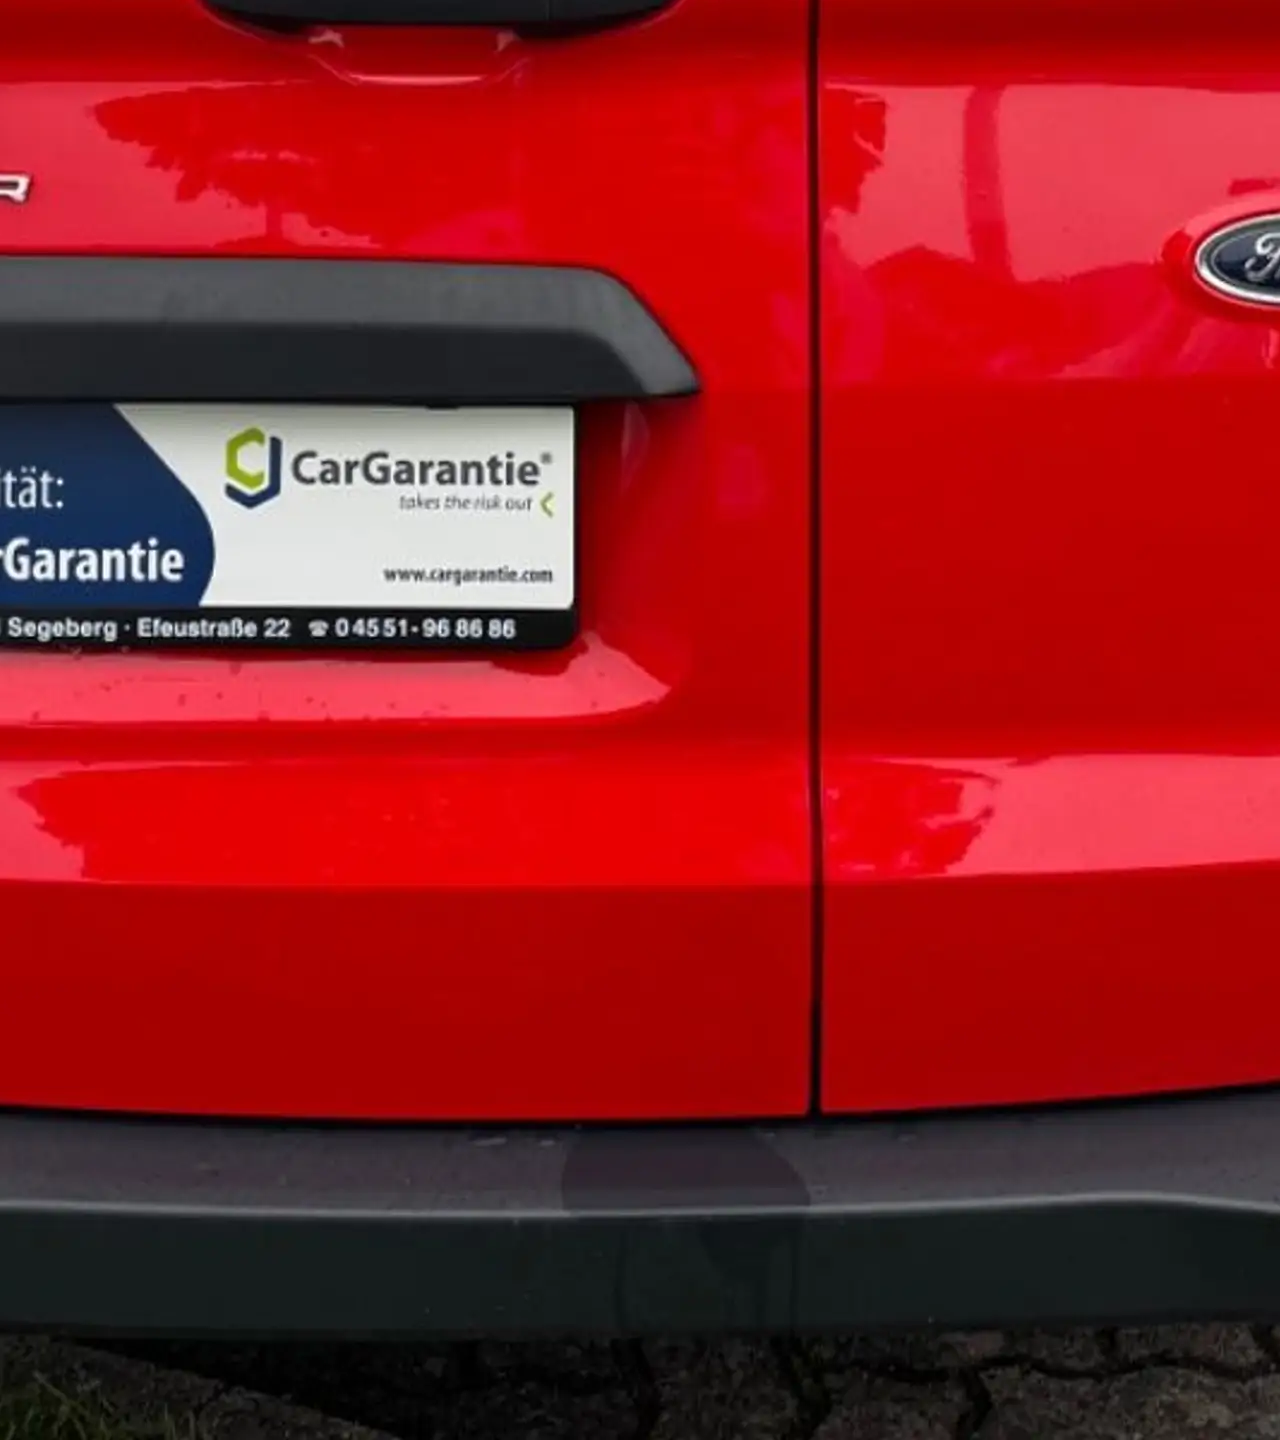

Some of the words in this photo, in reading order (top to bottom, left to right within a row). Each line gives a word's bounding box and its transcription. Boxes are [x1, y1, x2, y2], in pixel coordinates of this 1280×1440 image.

[399, 493, 441, 511] takes
[445, 494, 471, 511] the
[475, 494, 502, 511] risk
[505, 496, 533, 512] out
[382, 566, 554, 588] www.cargarantie.com
[7, 616, 119, 643] Segeberg
[136, 616, 259, 639] Efeustraße
[262, 617, 292, 639] 22
